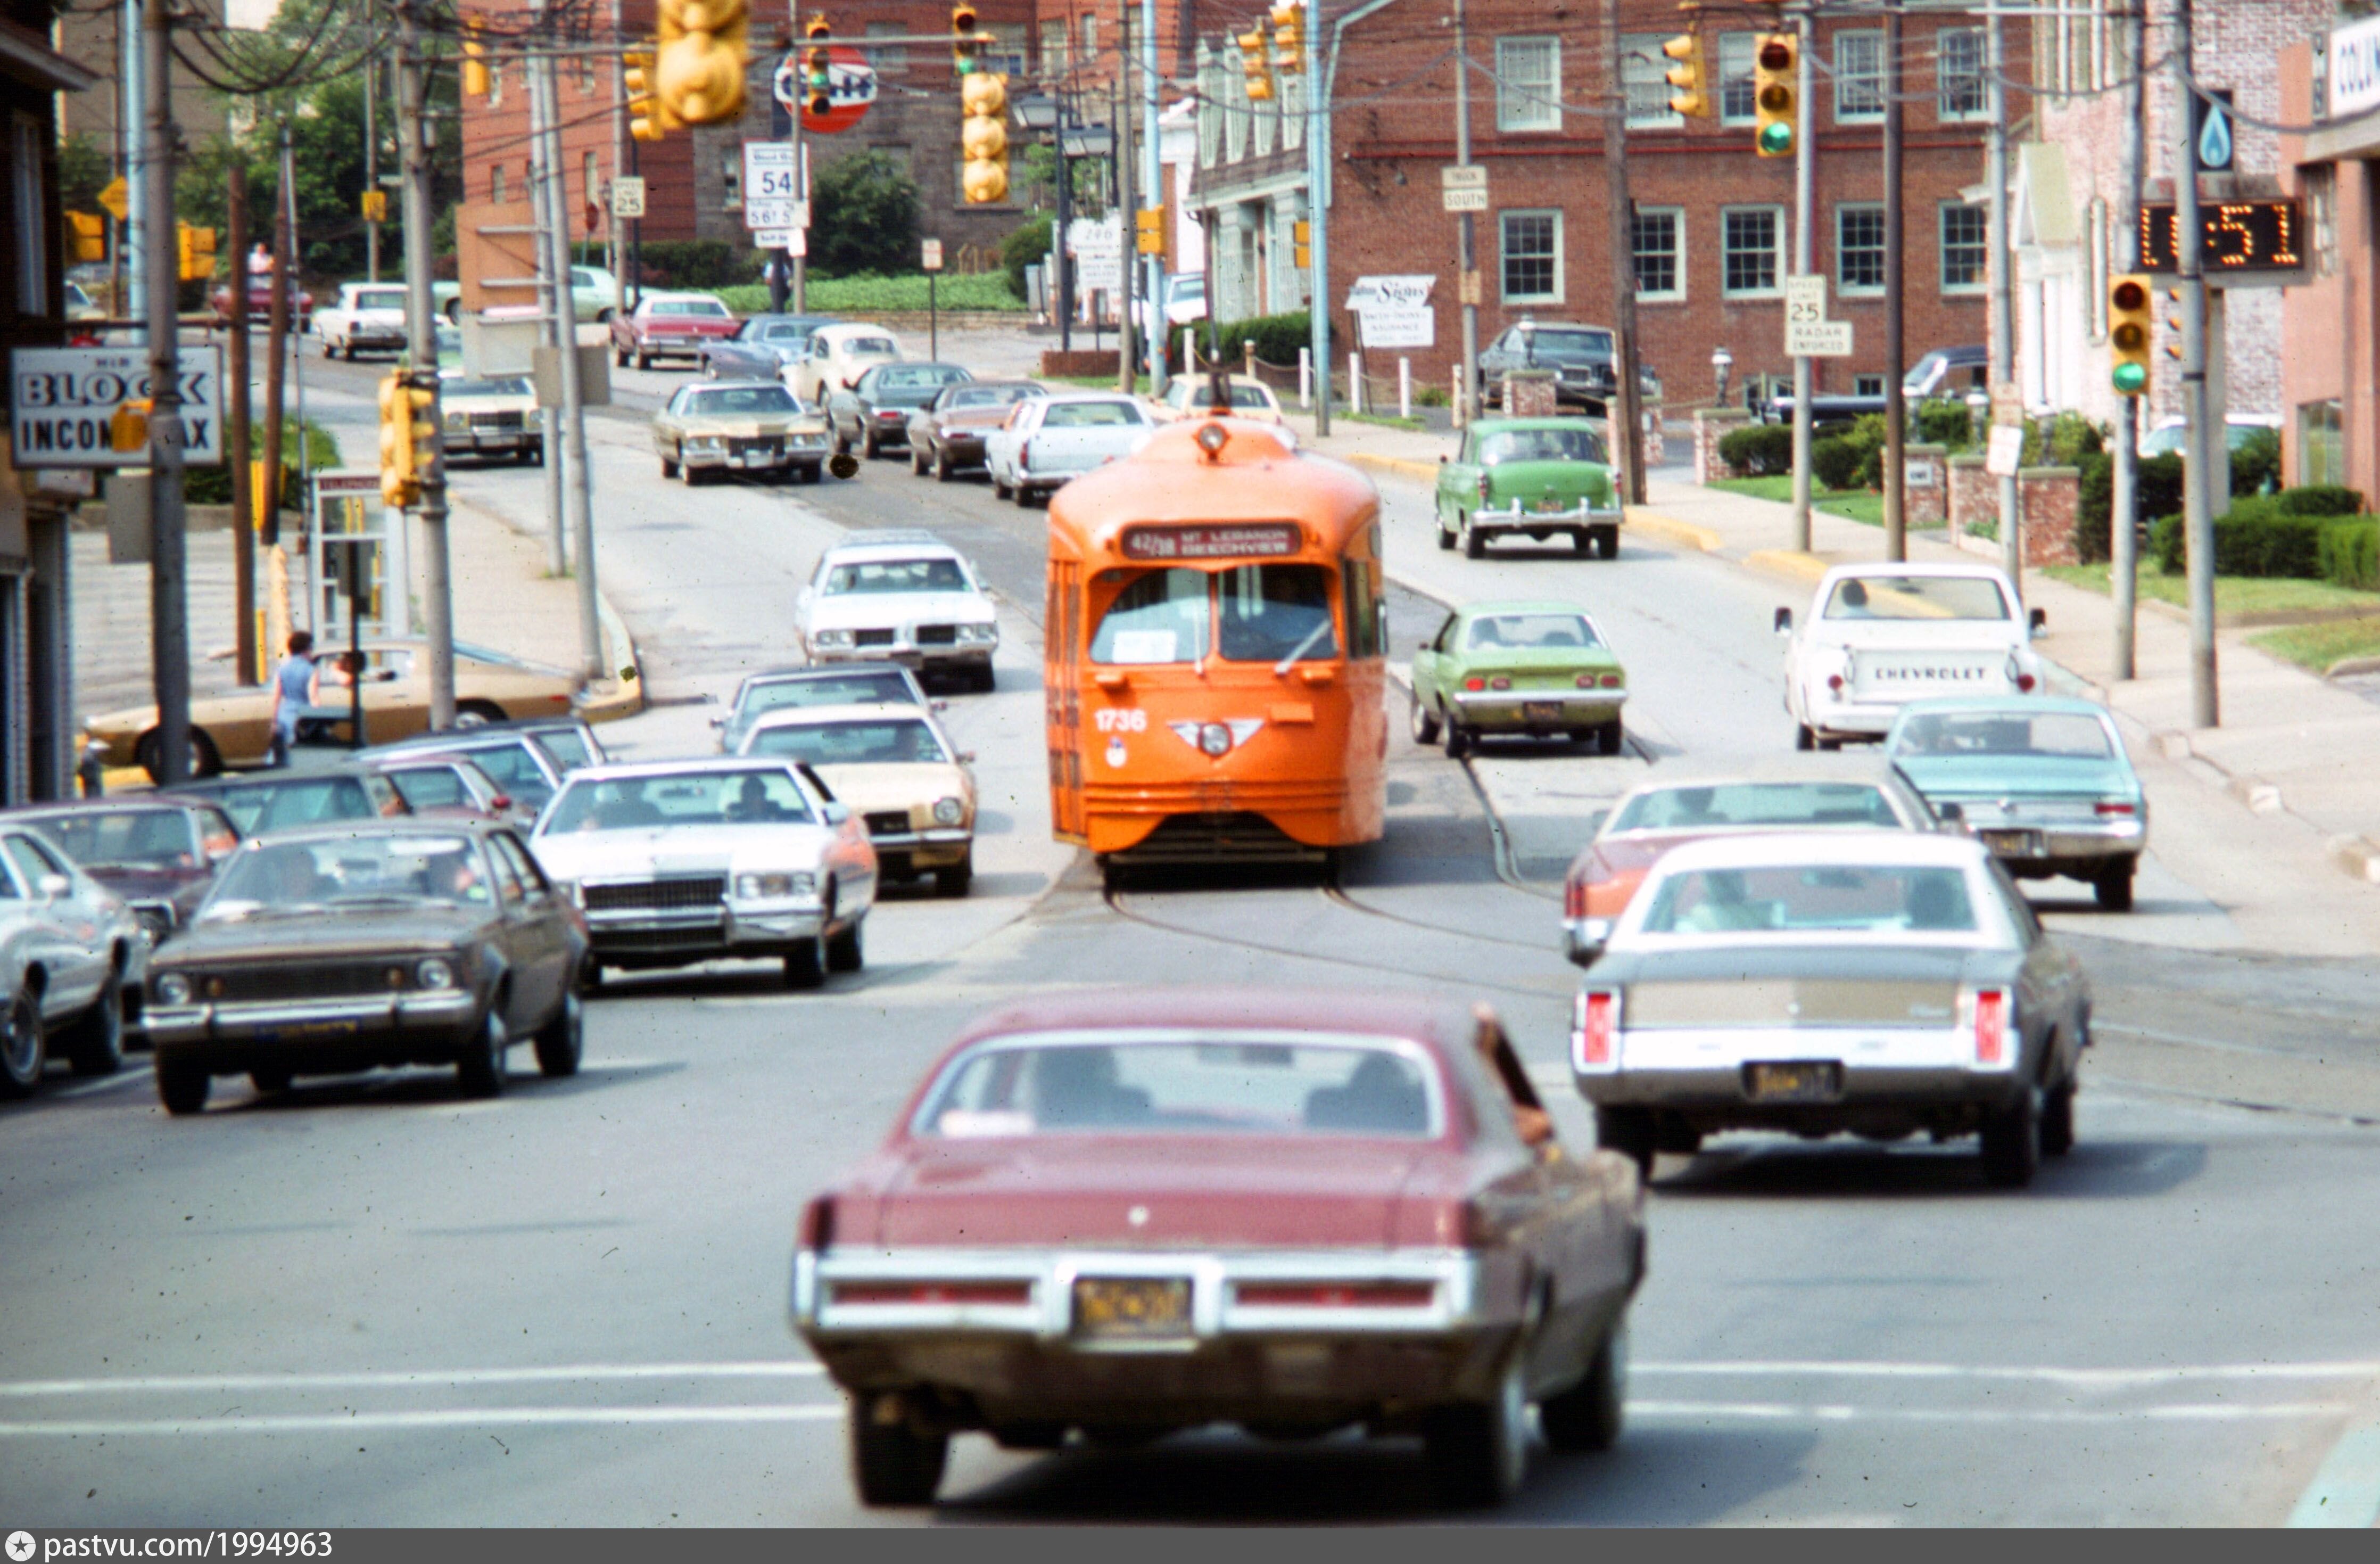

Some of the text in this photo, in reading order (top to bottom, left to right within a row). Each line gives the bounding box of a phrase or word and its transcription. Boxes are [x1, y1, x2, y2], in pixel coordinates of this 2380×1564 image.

[616, 197, 640, 212] 25
[1447, 193, 1485, 208] SOUTH
[1376, 280, 1424, 308] Signs
[1791, 302, 1819, 322] 25
[1795, 327, 1842, 338] RADAR
[1211, 530, 1288, 540] LEBANON
[1181, 542, 1288, 556] BEECHVIEW
[1875, 668, 1986, 680] CHEVROLET
[1095, 709, 1147, 732] 1736
